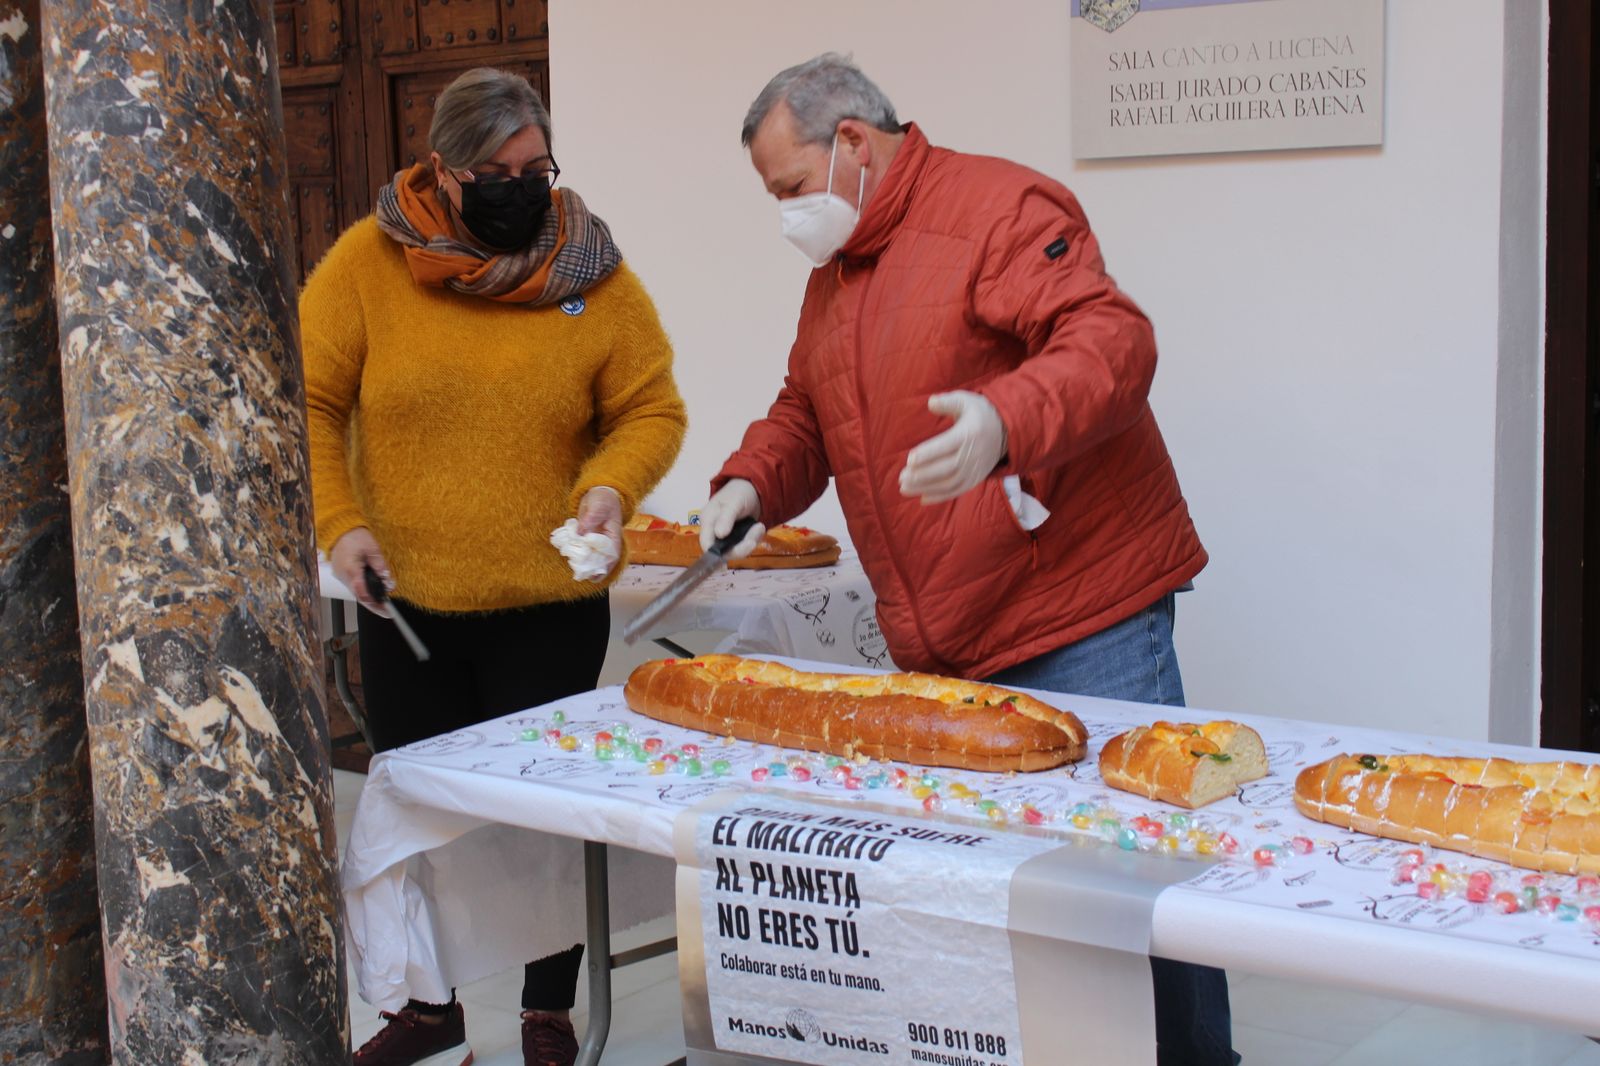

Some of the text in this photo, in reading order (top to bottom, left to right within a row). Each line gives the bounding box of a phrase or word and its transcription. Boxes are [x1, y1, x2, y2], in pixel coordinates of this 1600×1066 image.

[1109, 35, 1354, 72] SALA CANTO A LUCENA
[1110, 66, 1366, 103] ISABEL JURADO CABAÑES
[1110, 94, 1365, 127] RAFAEL AGUILERA BAENA
[712, 816, 896, 862] EL MALTRATO
[820, 816, 893, 833] MÁS
[892, 827, 994, 847] SUFRE
[715, 857, 861, 909] AL PLANETA
[717, 902, 870, 958] NO ERES TÚ.
[720, 953, 885, 992] Colaborar está en tu mano.
[728, 1016, 889, 1055] Manos Unidas
[908, 1022, 1007, 1056] 900 811 888
